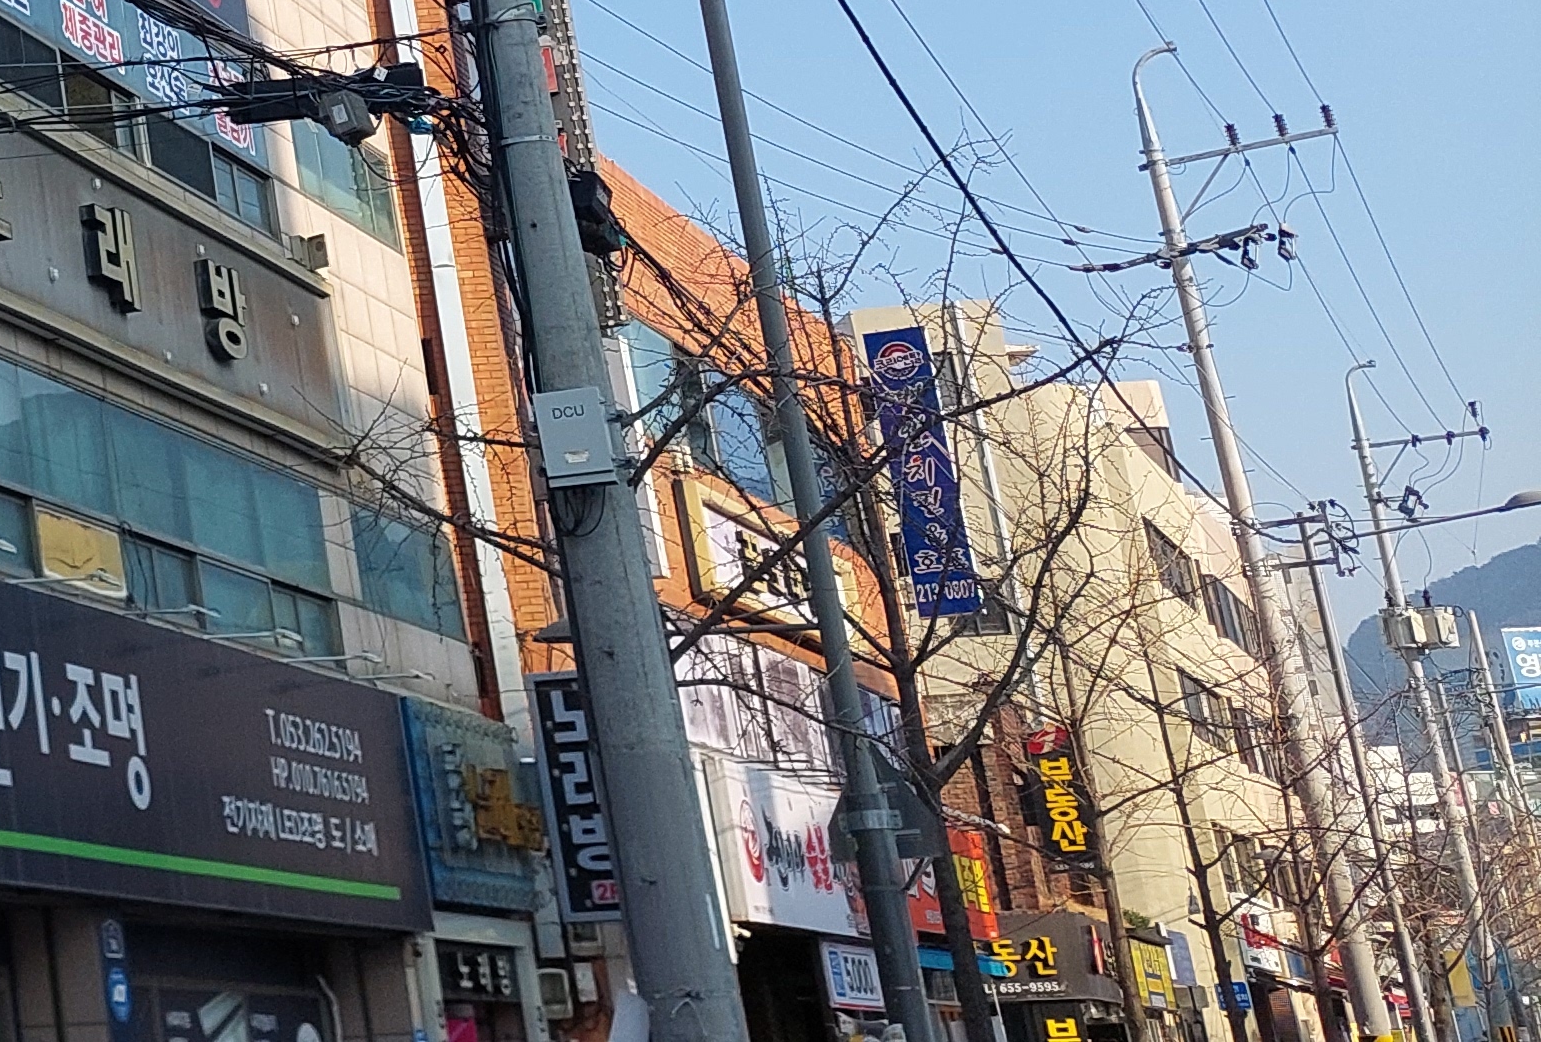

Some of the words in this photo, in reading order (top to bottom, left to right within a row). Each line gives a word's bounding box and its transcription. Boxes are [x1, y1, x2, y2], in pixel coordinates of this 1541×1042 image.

[551, 405, 585, 420] DCU
[1039, 756, 1088, 853] 부동산
[991, 936, 1058, 976] 동산
[999, 981, 1059, 994] 655-9595
